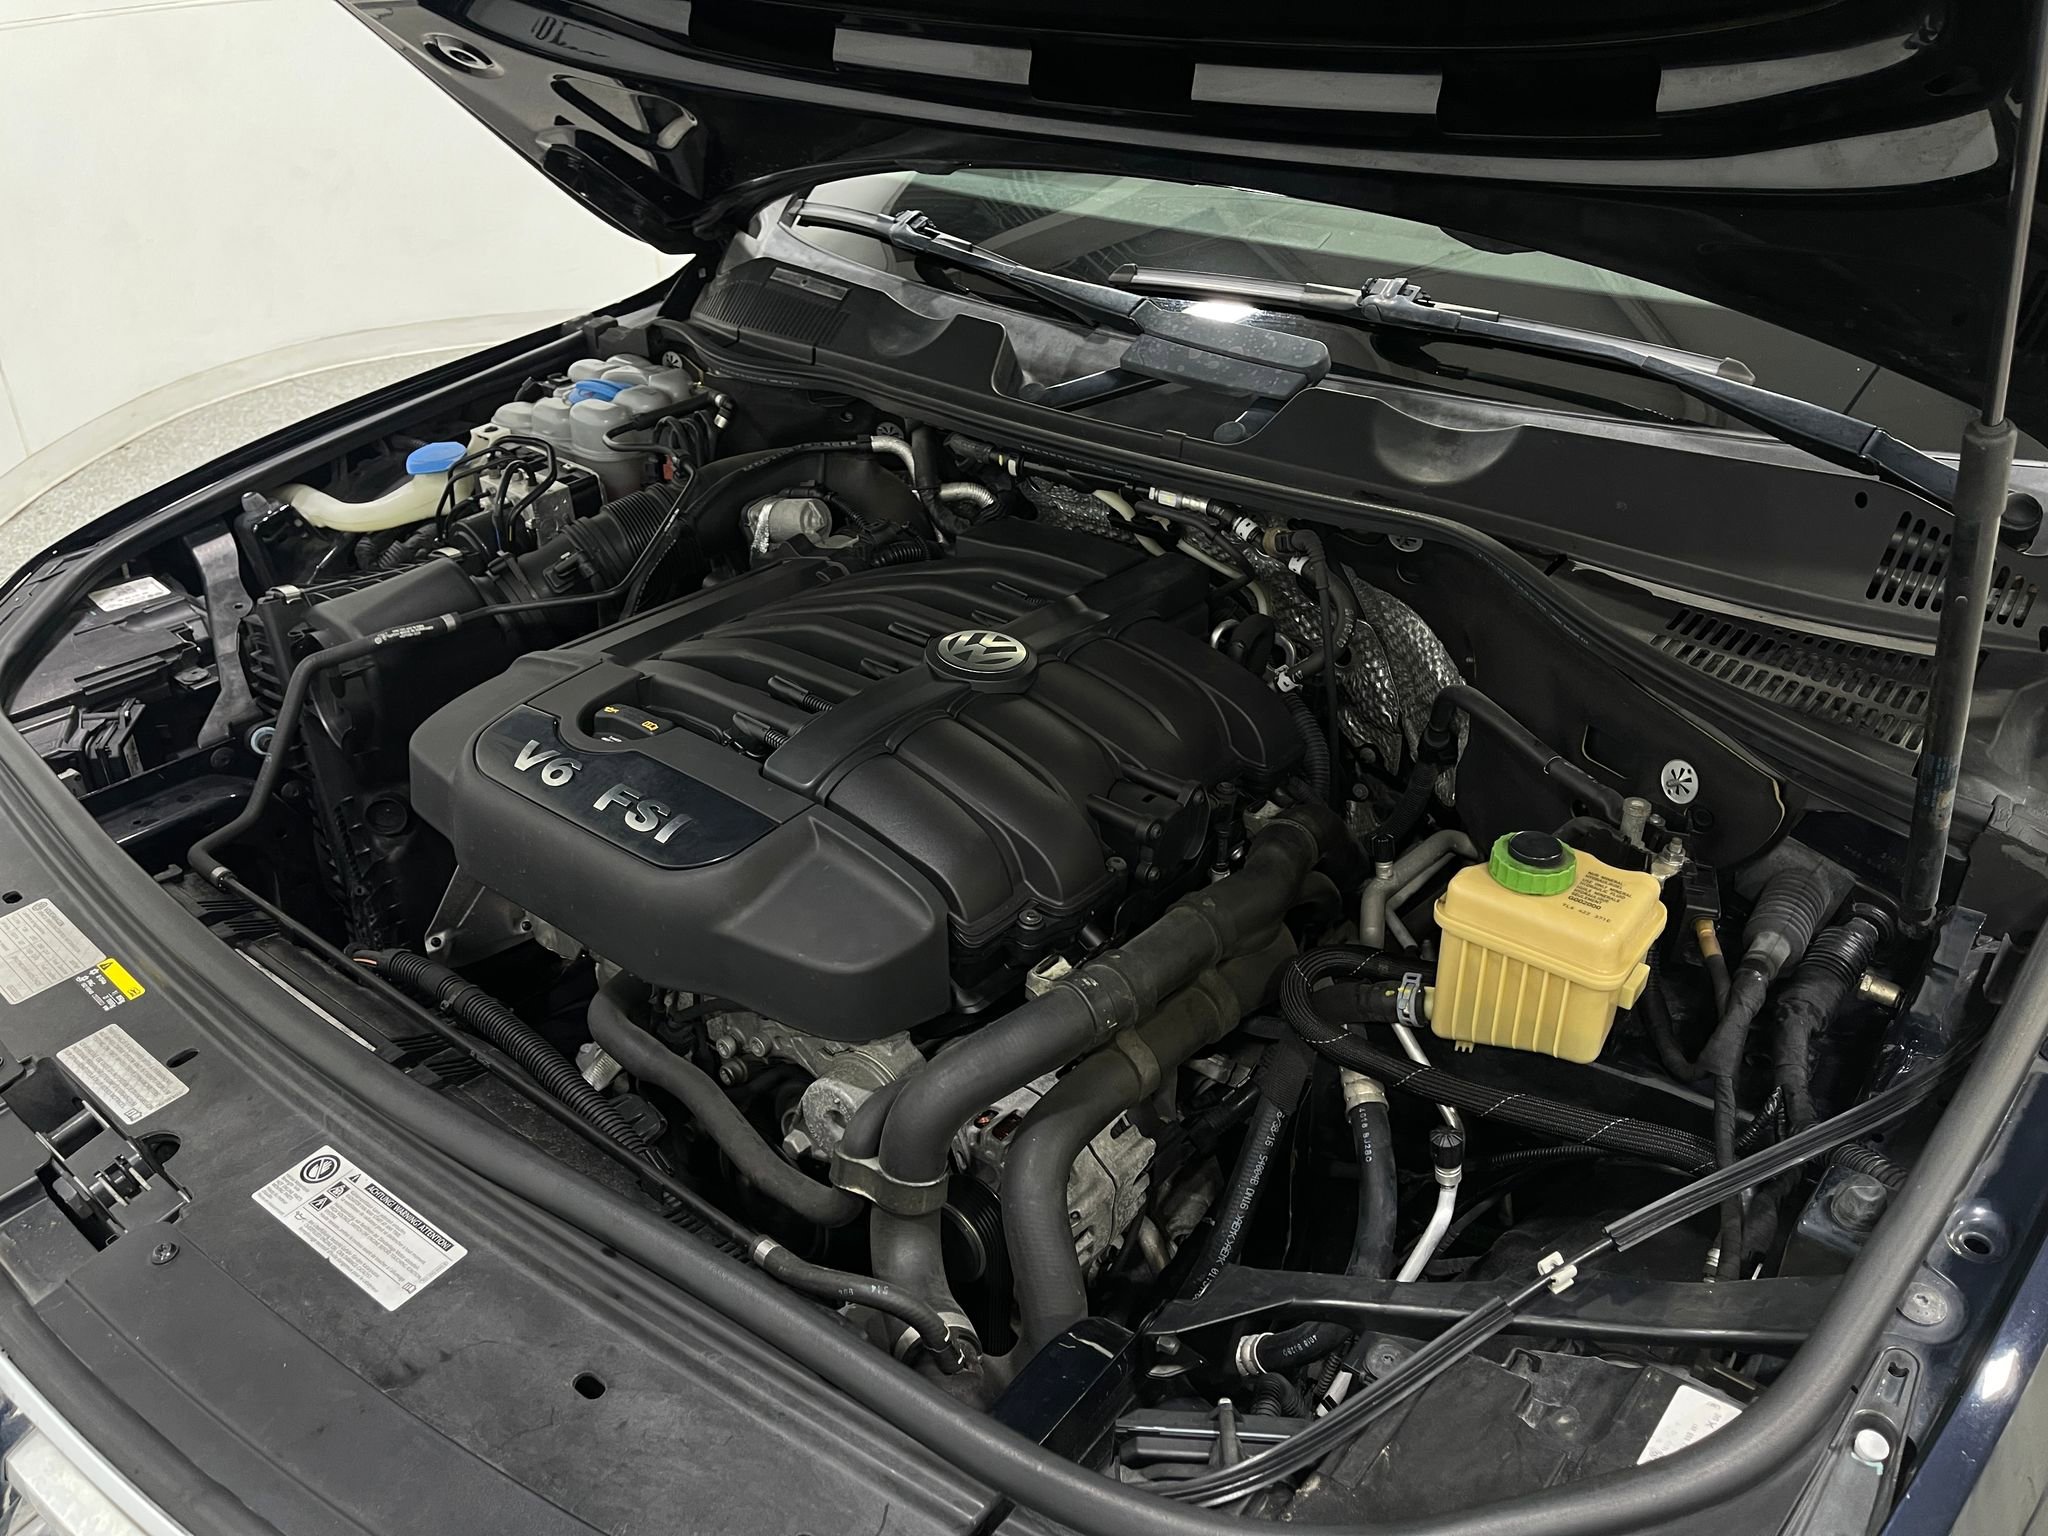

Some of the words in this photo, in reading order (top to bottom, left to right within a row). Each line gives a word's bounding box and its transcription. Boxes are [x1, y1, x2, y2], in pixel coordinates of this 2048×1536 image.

[514, 739, 583, 787] V6
[593, 783, 693, 844] FSI
[367, 1185, 396, 1208] ACHTUNG!
[393, 1204, 422, 1228] WARNING!
[418, 1224, 452, 1250] ATTENTION!
